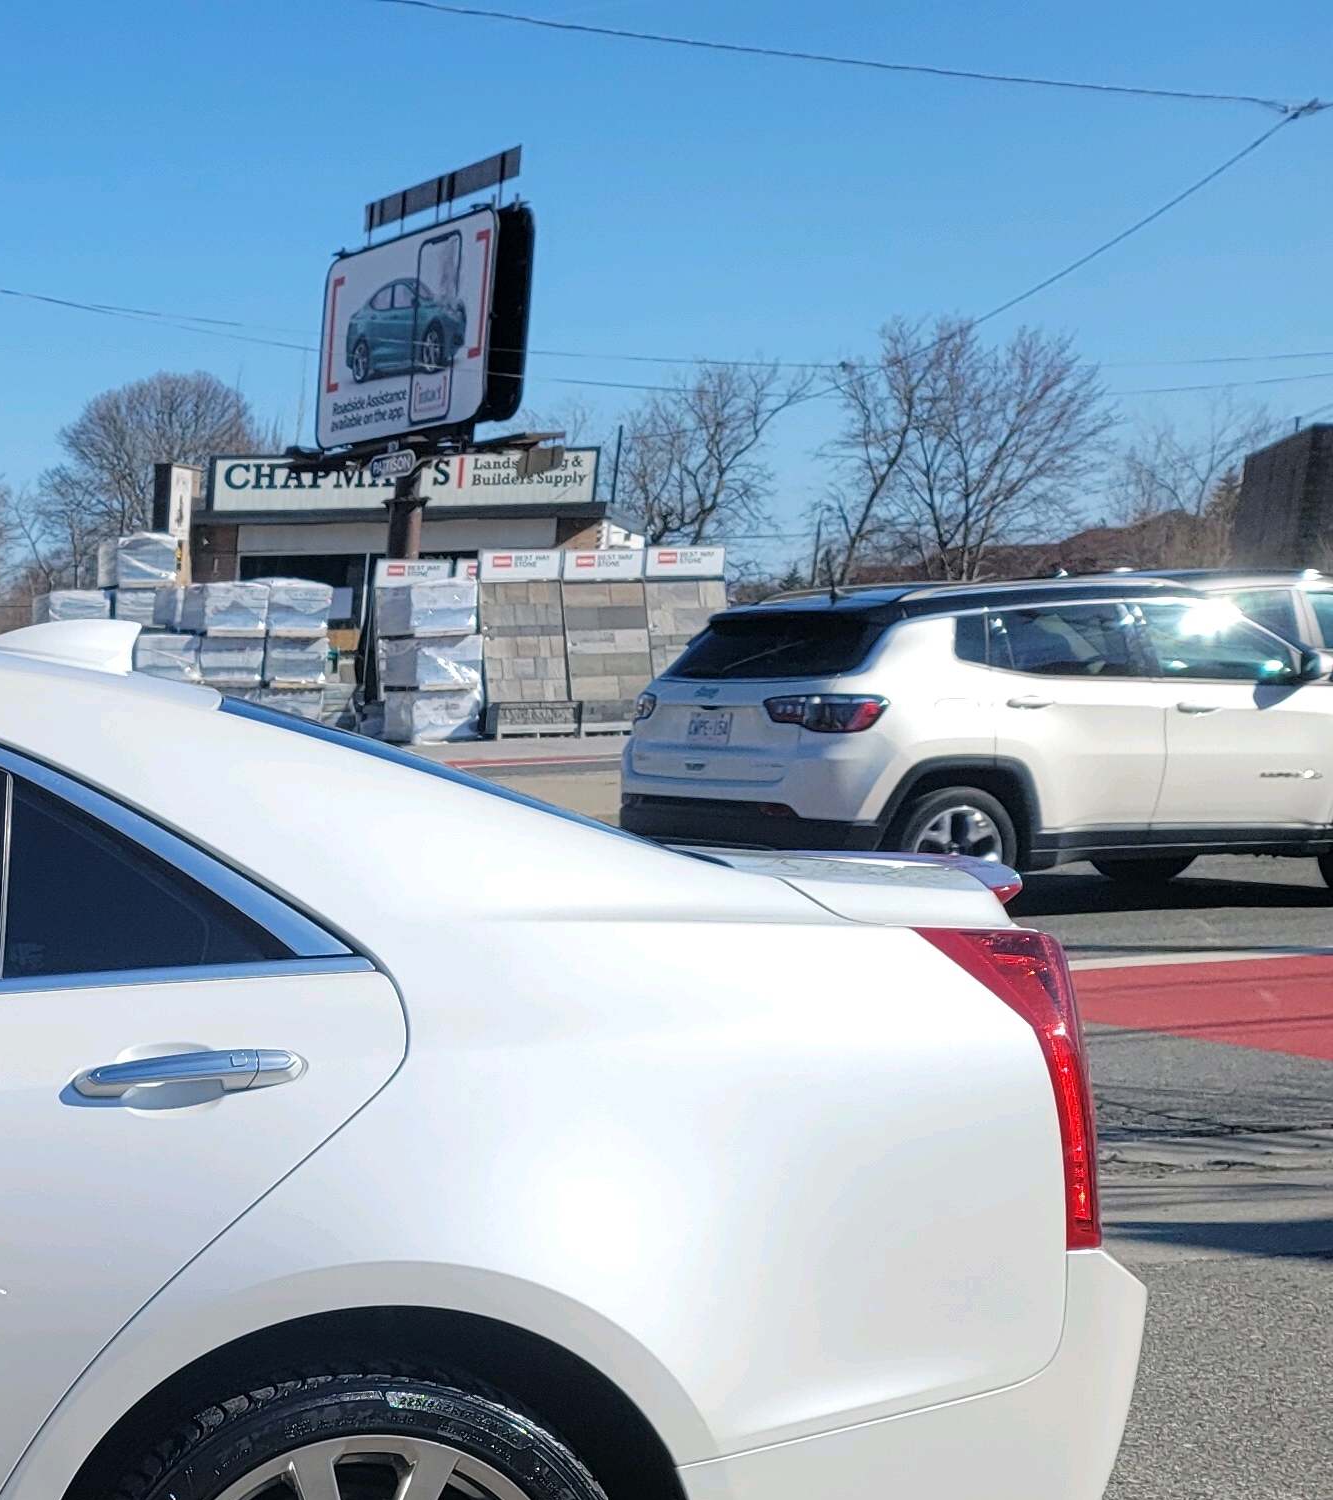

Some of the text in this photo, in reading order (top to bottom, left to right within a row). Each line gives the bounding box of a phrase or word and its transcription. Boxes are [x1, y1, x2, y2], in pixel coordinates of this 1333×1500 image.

[333, 389, 407, 416] Roadside Assistance
[373, 455, 411, 474] PATTISON
[571, 455, 583, 468] &
[471, 471, 588, 487] Builders Supply
